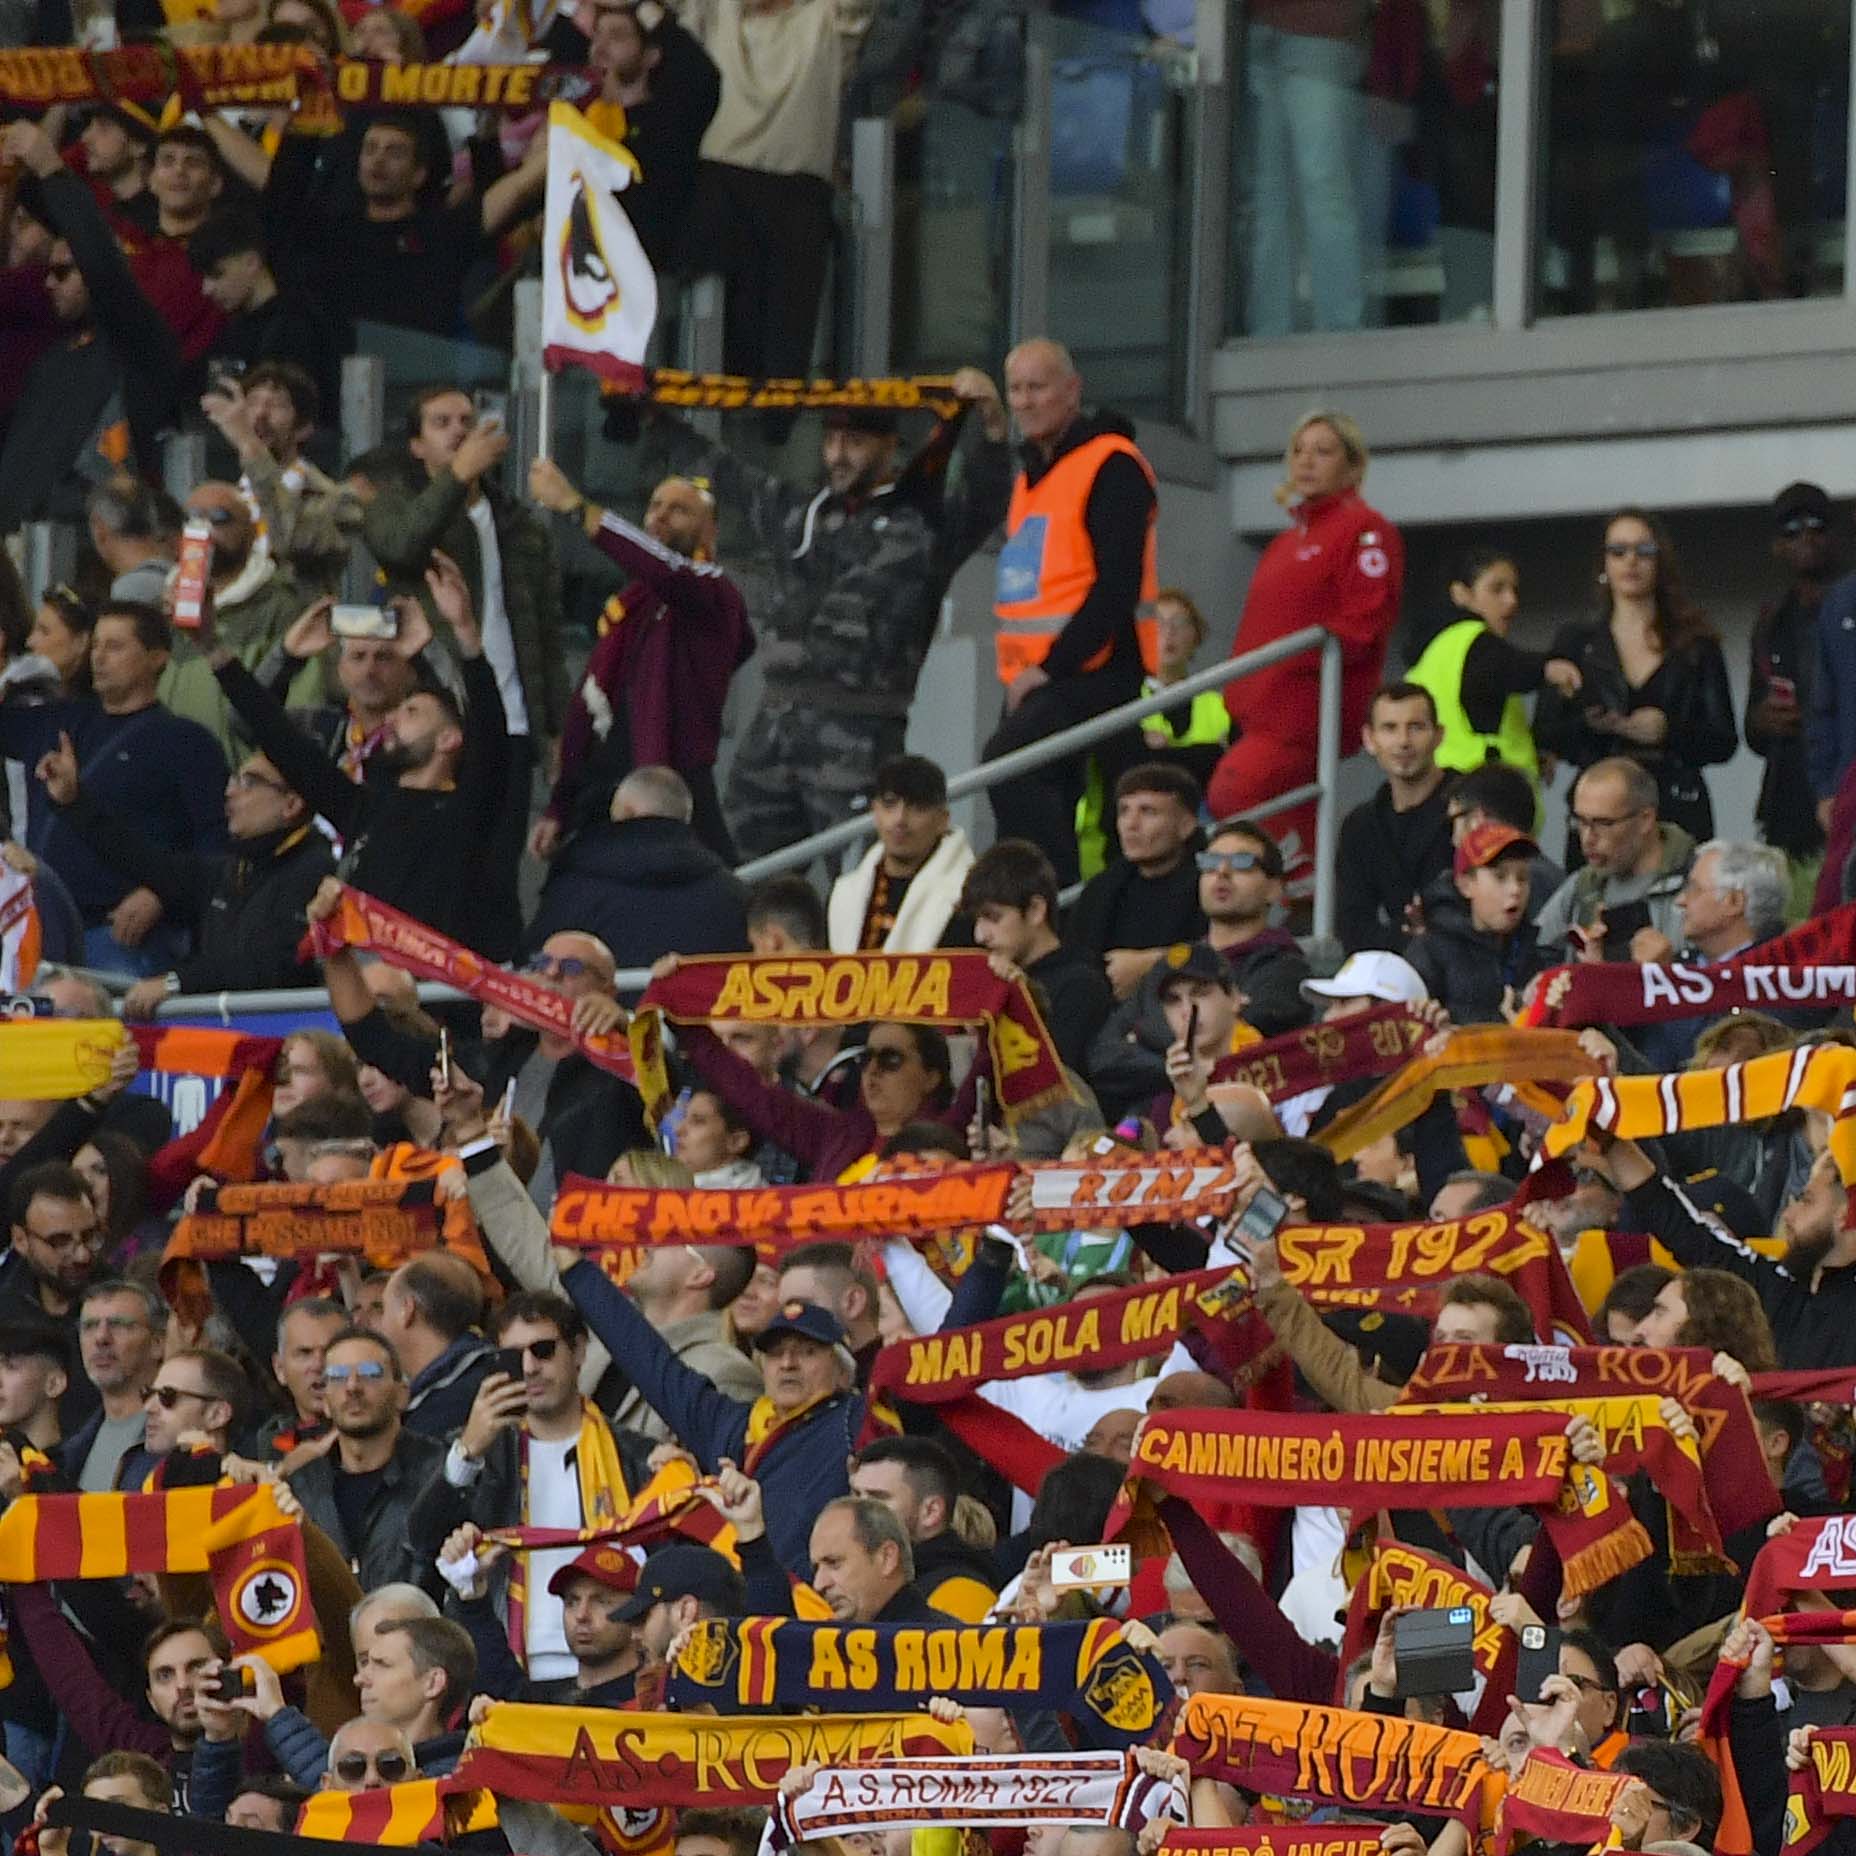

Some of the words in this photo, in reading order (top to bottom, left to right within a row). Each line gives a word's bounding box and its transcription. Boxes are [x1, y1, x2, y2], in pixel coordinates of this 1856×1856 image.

[338, 63, 369, 100] O
[381, 64, 542, 103] MORTE
[712, 957, 952, 1018] ASROMA
[1643, 962, 1712, 1007] AS
[906, 1330, 982, 1386] MAI
[1003, 1310, 1100, 1378] SOLA
[1142, 1429, 1344, 1482] CAMMINERÒ
[1354, 1439, 1492, 1482] INSIEME
[1499, 1437, 1525, 1479] A
[808, 1628, 877, 1689] AS
[894, 1627, 1042, 1691] ROMA
[564, 1723, 647, 1793] AS
[693, 1716, 905, 1793] ROMA
[1295, 1704, 1490, 1813] ROMA
[883, 1773, 998, 1805] ROMA
[1010, 1774, 1091, 1804] 1927
